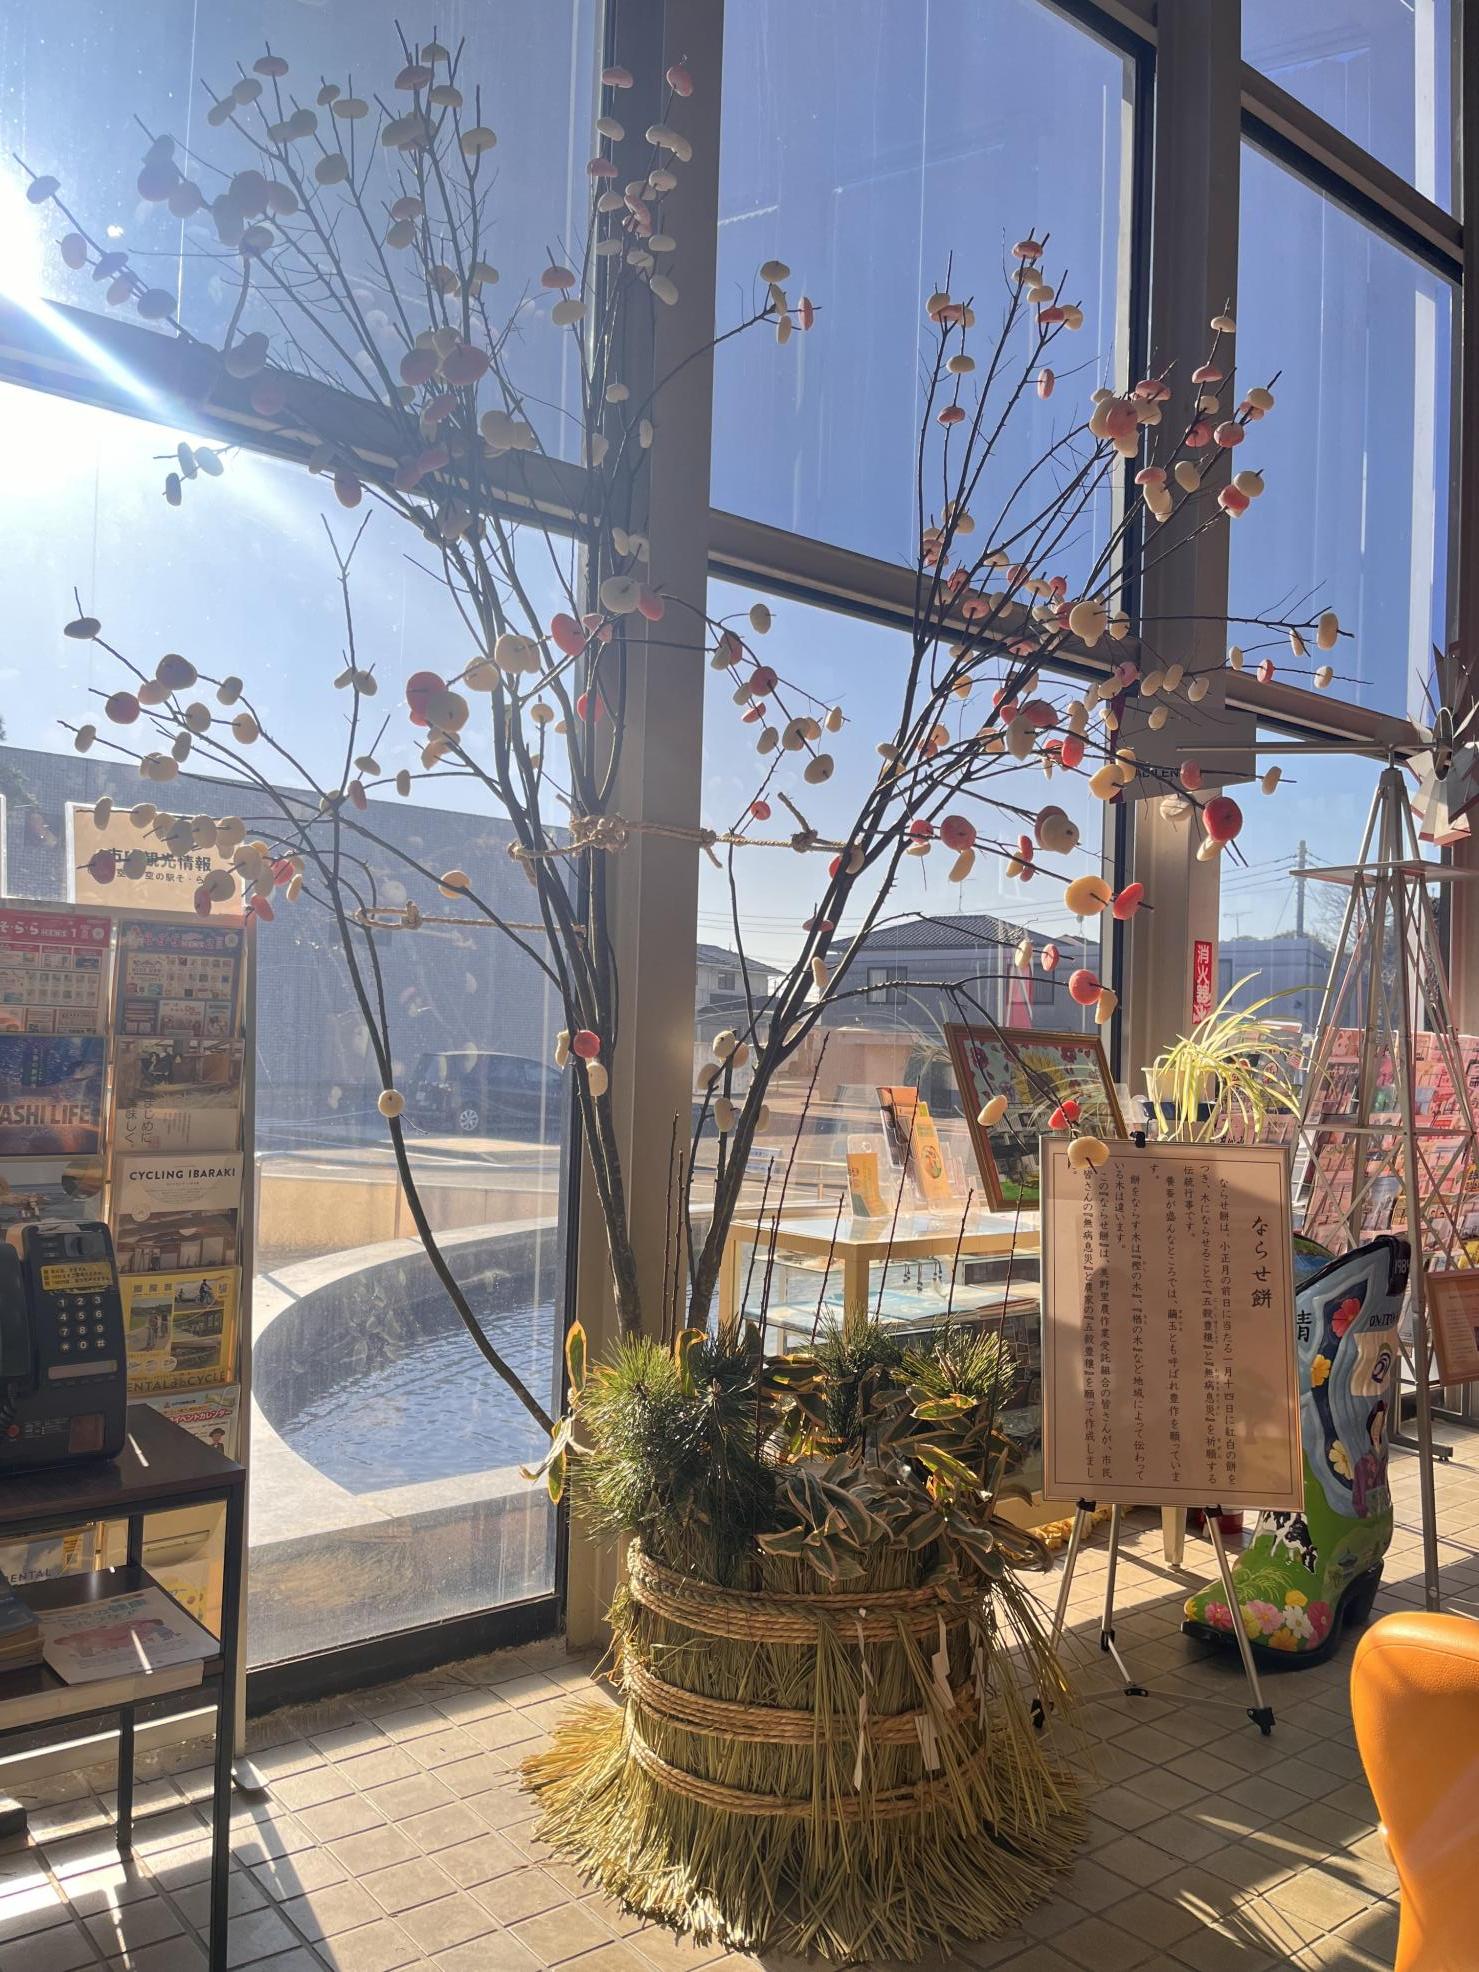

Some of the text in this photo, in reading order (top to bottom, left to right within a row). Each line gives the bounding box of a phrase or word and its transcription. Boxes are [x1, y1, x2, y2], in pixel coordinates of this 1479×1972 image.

[0, 1104, 91, 1125] ASHI LIFE
[129, 1168, 236, 1181] CYCLING IBARAKI
[1151, 1163, 1160, 1180] す。
[1114, 1162, 1126, 1249] いる木は違います。
[1184, 1165, 1195, 1238] 伝統行事です。
[1251, 1216, 1272, 1309] ならせ餅
[1082, 1168, 1096, 1478] 皆さんの『無病息災』と農家の『五穀豊穣』を願って作成しまし
[1296, 1310, 1312, 1342] 青
[127, 1379, 170, 1393] ENTAL
[187, 1371, 226, 1386] CYCLE
[11, 1568, 51, 1583] ENTAL
